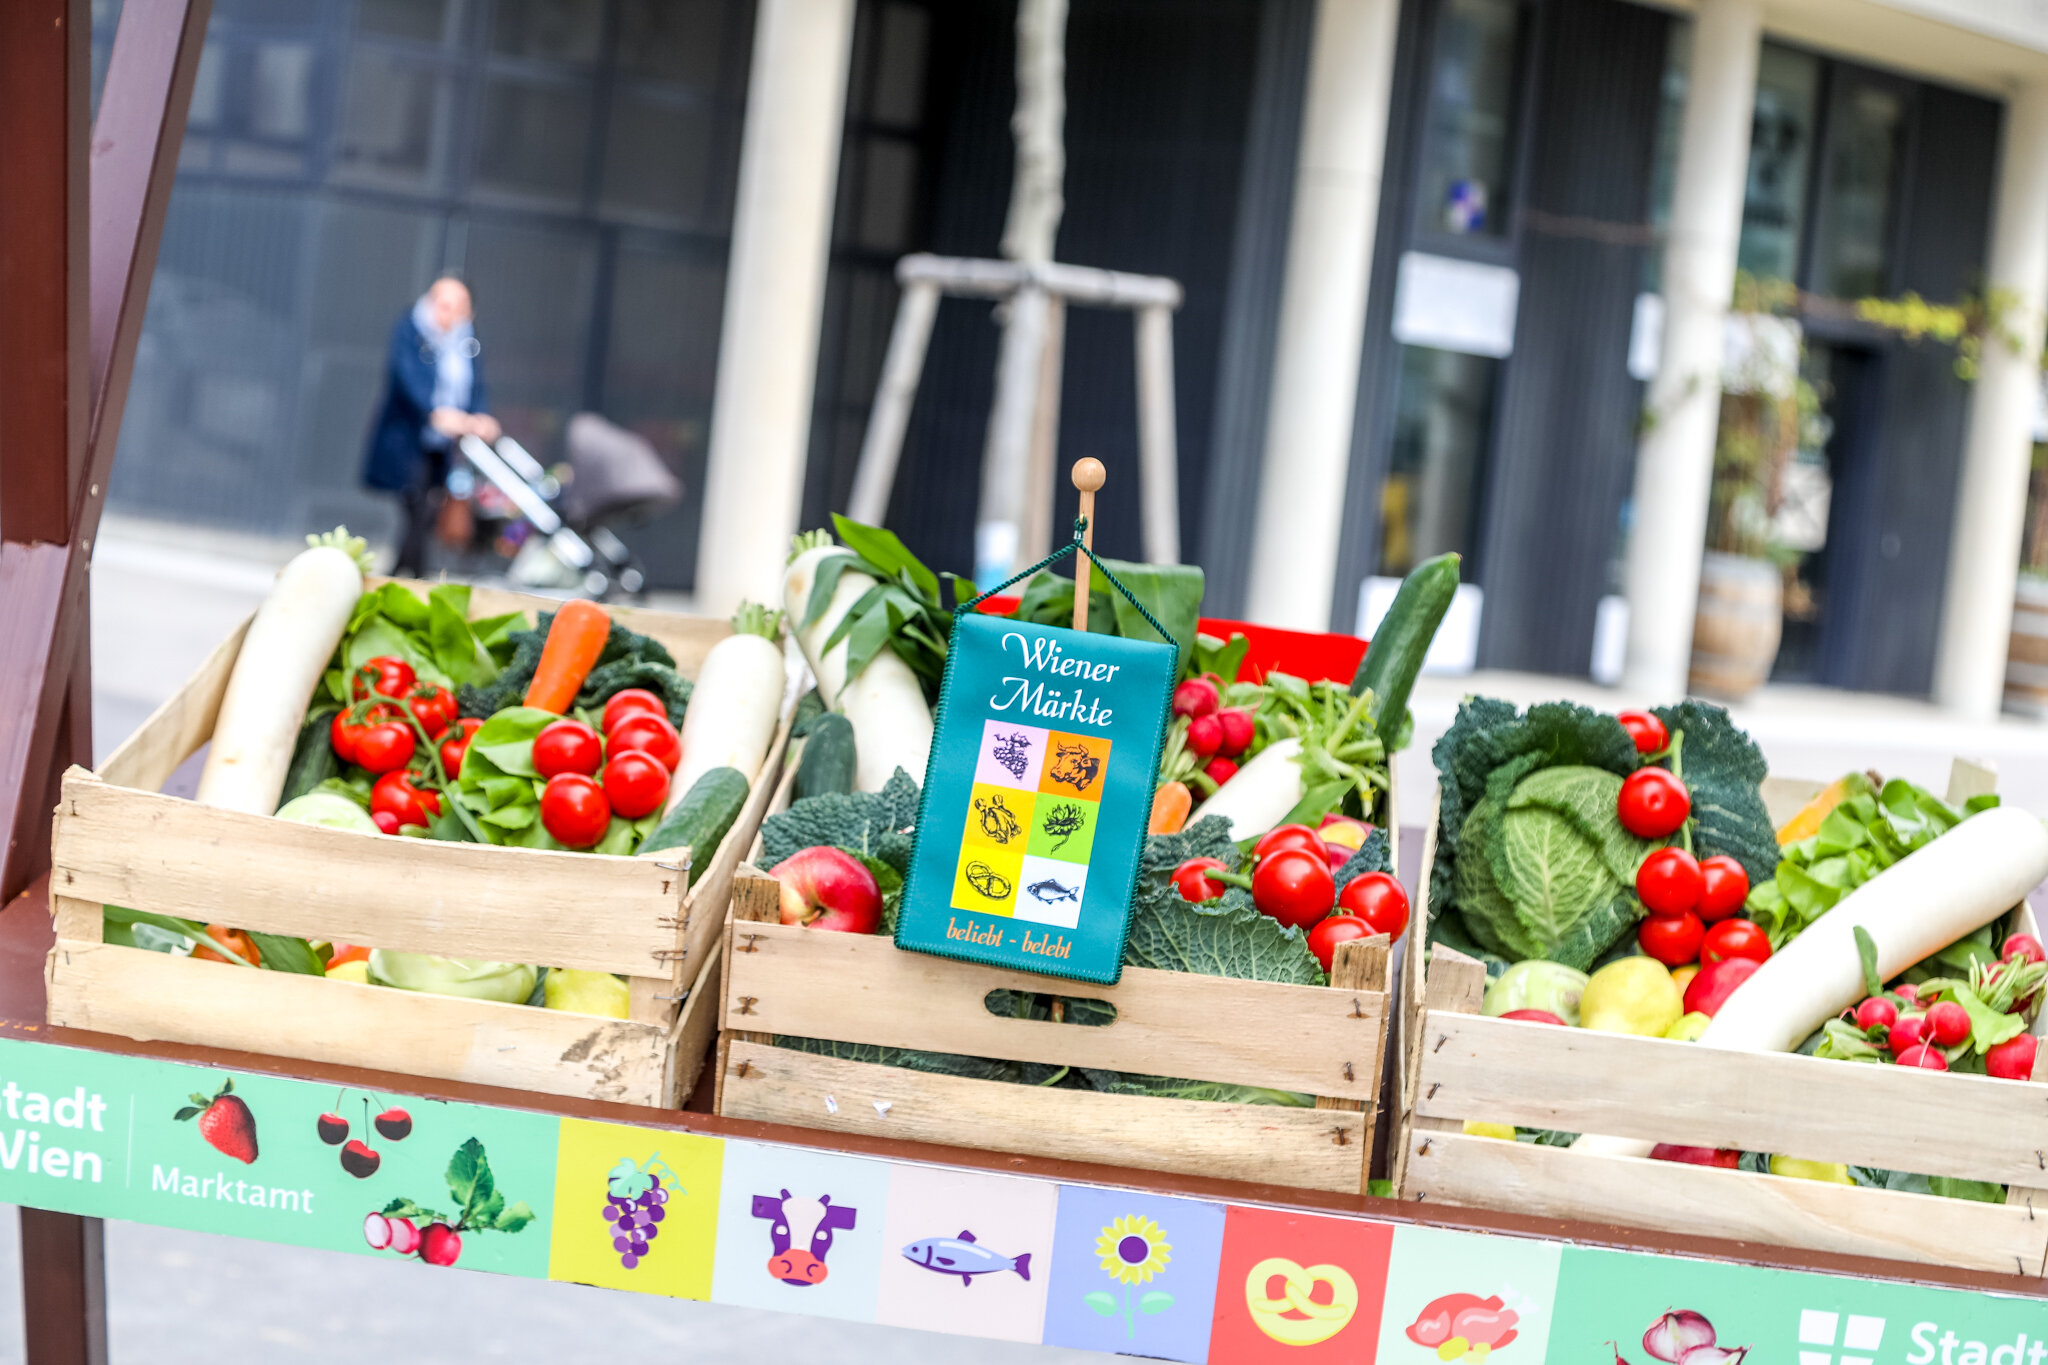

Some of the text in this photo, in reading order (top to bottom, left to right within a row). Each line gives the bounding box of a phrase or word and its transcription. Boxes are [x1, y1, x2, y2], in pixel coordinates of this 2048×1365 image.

[1002, 632, 1120, 682] Wiener
[990, 677, 1113, 726] Märkte
[946, 917, 1002, 947] beliebt
[1021, 937, 1072, 959] belebt
[0, 1079, 107, 1132] tadt
[151, 1164, 315, 1213] Marktamt
[1906, 1321, 2048, 1365] Stadt
